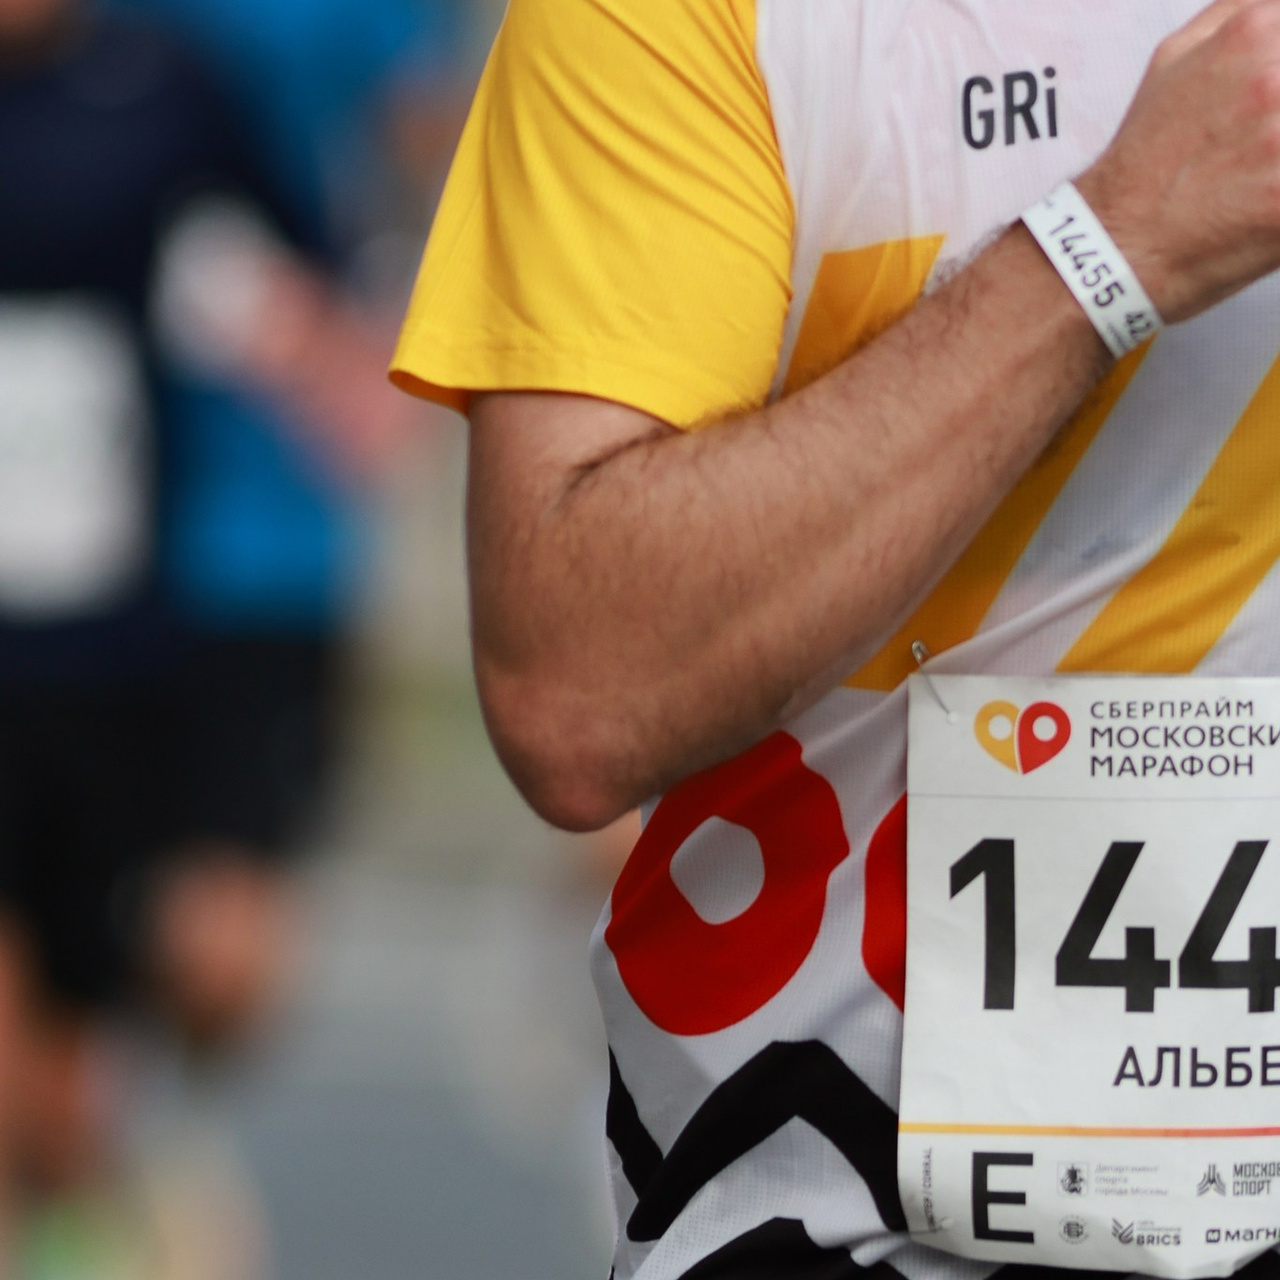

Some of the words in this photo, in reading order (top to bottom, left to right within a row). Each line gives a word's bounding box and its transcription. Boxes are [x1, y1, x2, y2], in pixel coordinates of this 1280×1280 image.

[962, 65, 1058, 150] GRi
[1049, 215, 1125, 308] 14455
[1090, 697, 1253, 719] СБЕРПРАЙМ
[1090, 754, 1253, 777] МАРАФОН
[1232, 1179, 1271, 1196] СПОРТ
[1136, 1234, 1181, 1246] BRICS
